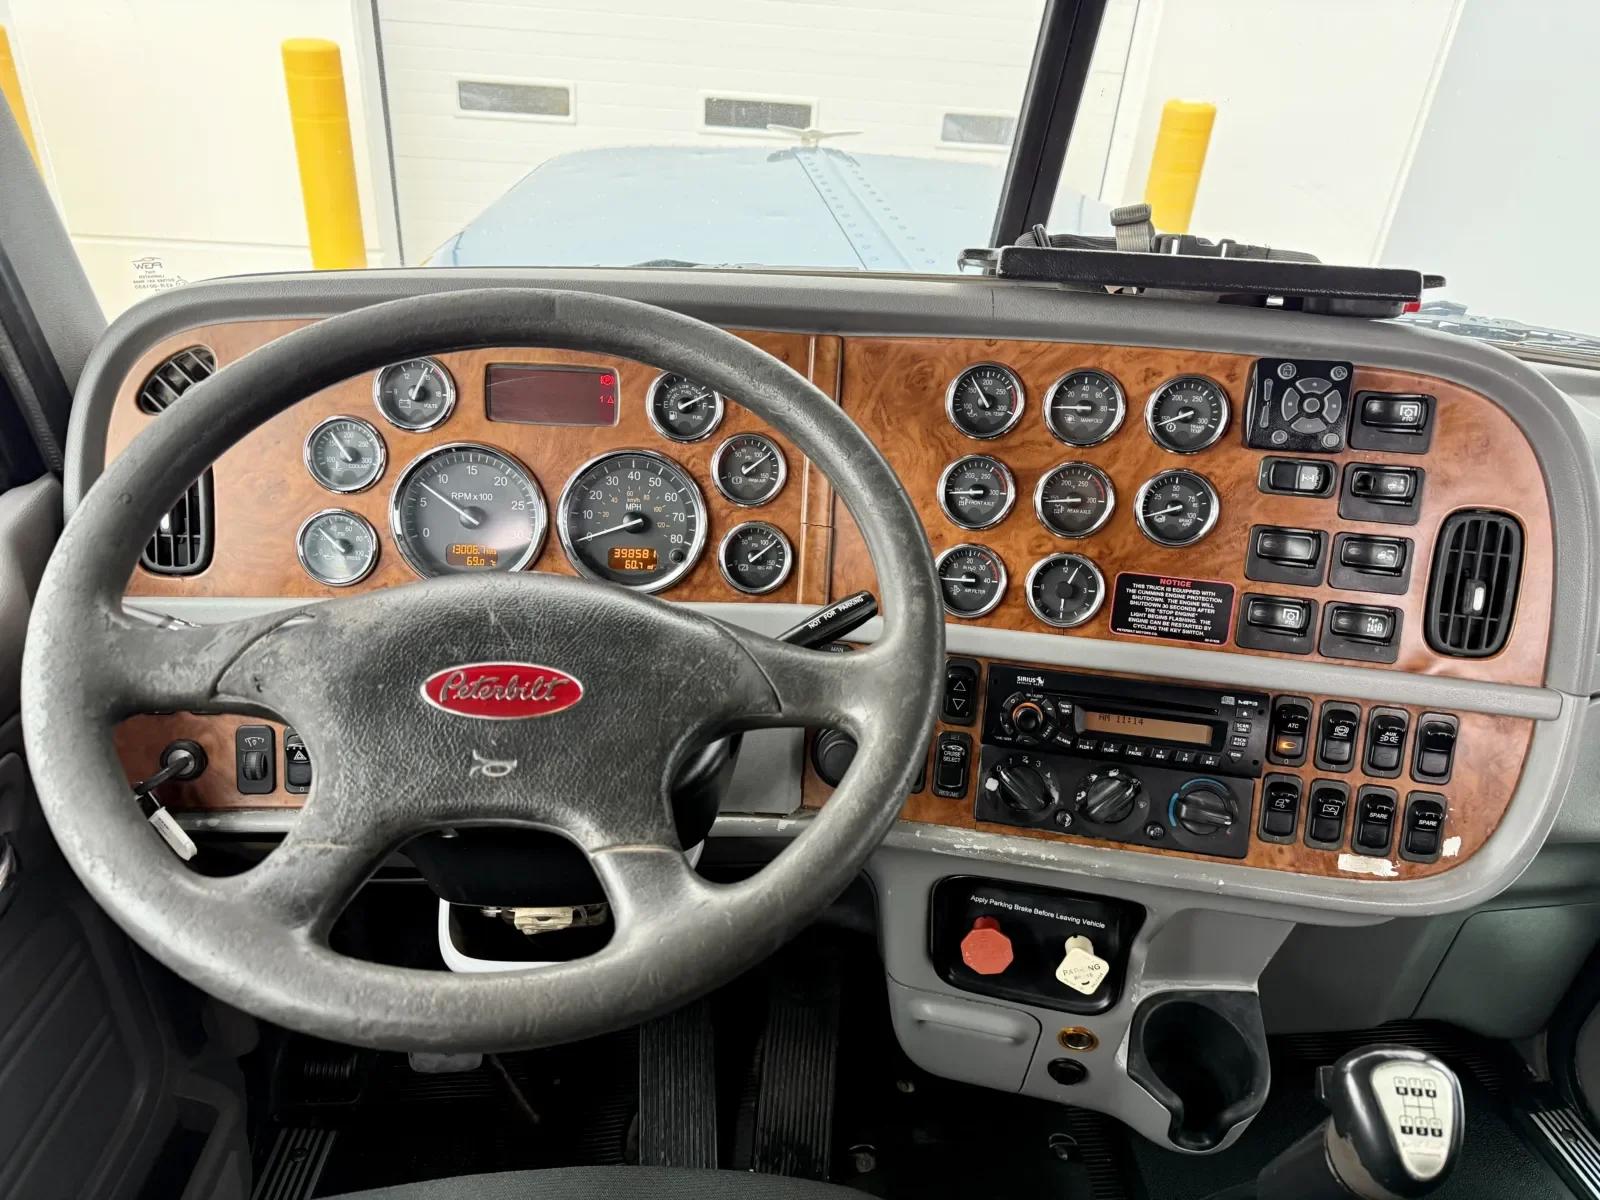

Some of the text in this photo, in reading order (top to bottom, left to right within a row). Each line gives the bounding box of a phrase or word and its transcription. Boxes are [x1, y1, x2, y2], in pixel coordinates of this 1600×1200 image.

[466, 466, 478, 475] 15
[438, 474, 448, 484] 10
[628, 471, 640, 480] 40
[494, 476, 507, 486] 20
[606, 476, 618, 486] 30
[649, 477, 661, 487] 50
[590, 491, 602, 500] 20
[665, 492, 677, 502] 60
[420, 498, 427, 507] 5
[512, 501, 524, 510] 25
[583, 510, 592, 519] 10
[673, 513, 684, 522] 70
[423, 528, 429, 537] 0
[670, 535, 683, 543] 80
[625, 560, 643, 569] 60.7
[1160, 578, 1192, 588] NOTICE
[1187, 595, 1222, 603] PROTECTION
[808, 596, 864, 629] NOT FOR PARKING
[1169, 615, 1197, 623] FLASHING.
[1170, 622, 1202, 630] RESTARTED
[440, 670, 570, 703] Peterbilt
[1116, 716, 1144, 725] 11:14
[1056, 736, 1071, 745] ALARM
[971, 895, 1106, 929] Apply Parking Brake Before Leaving Vehicle
